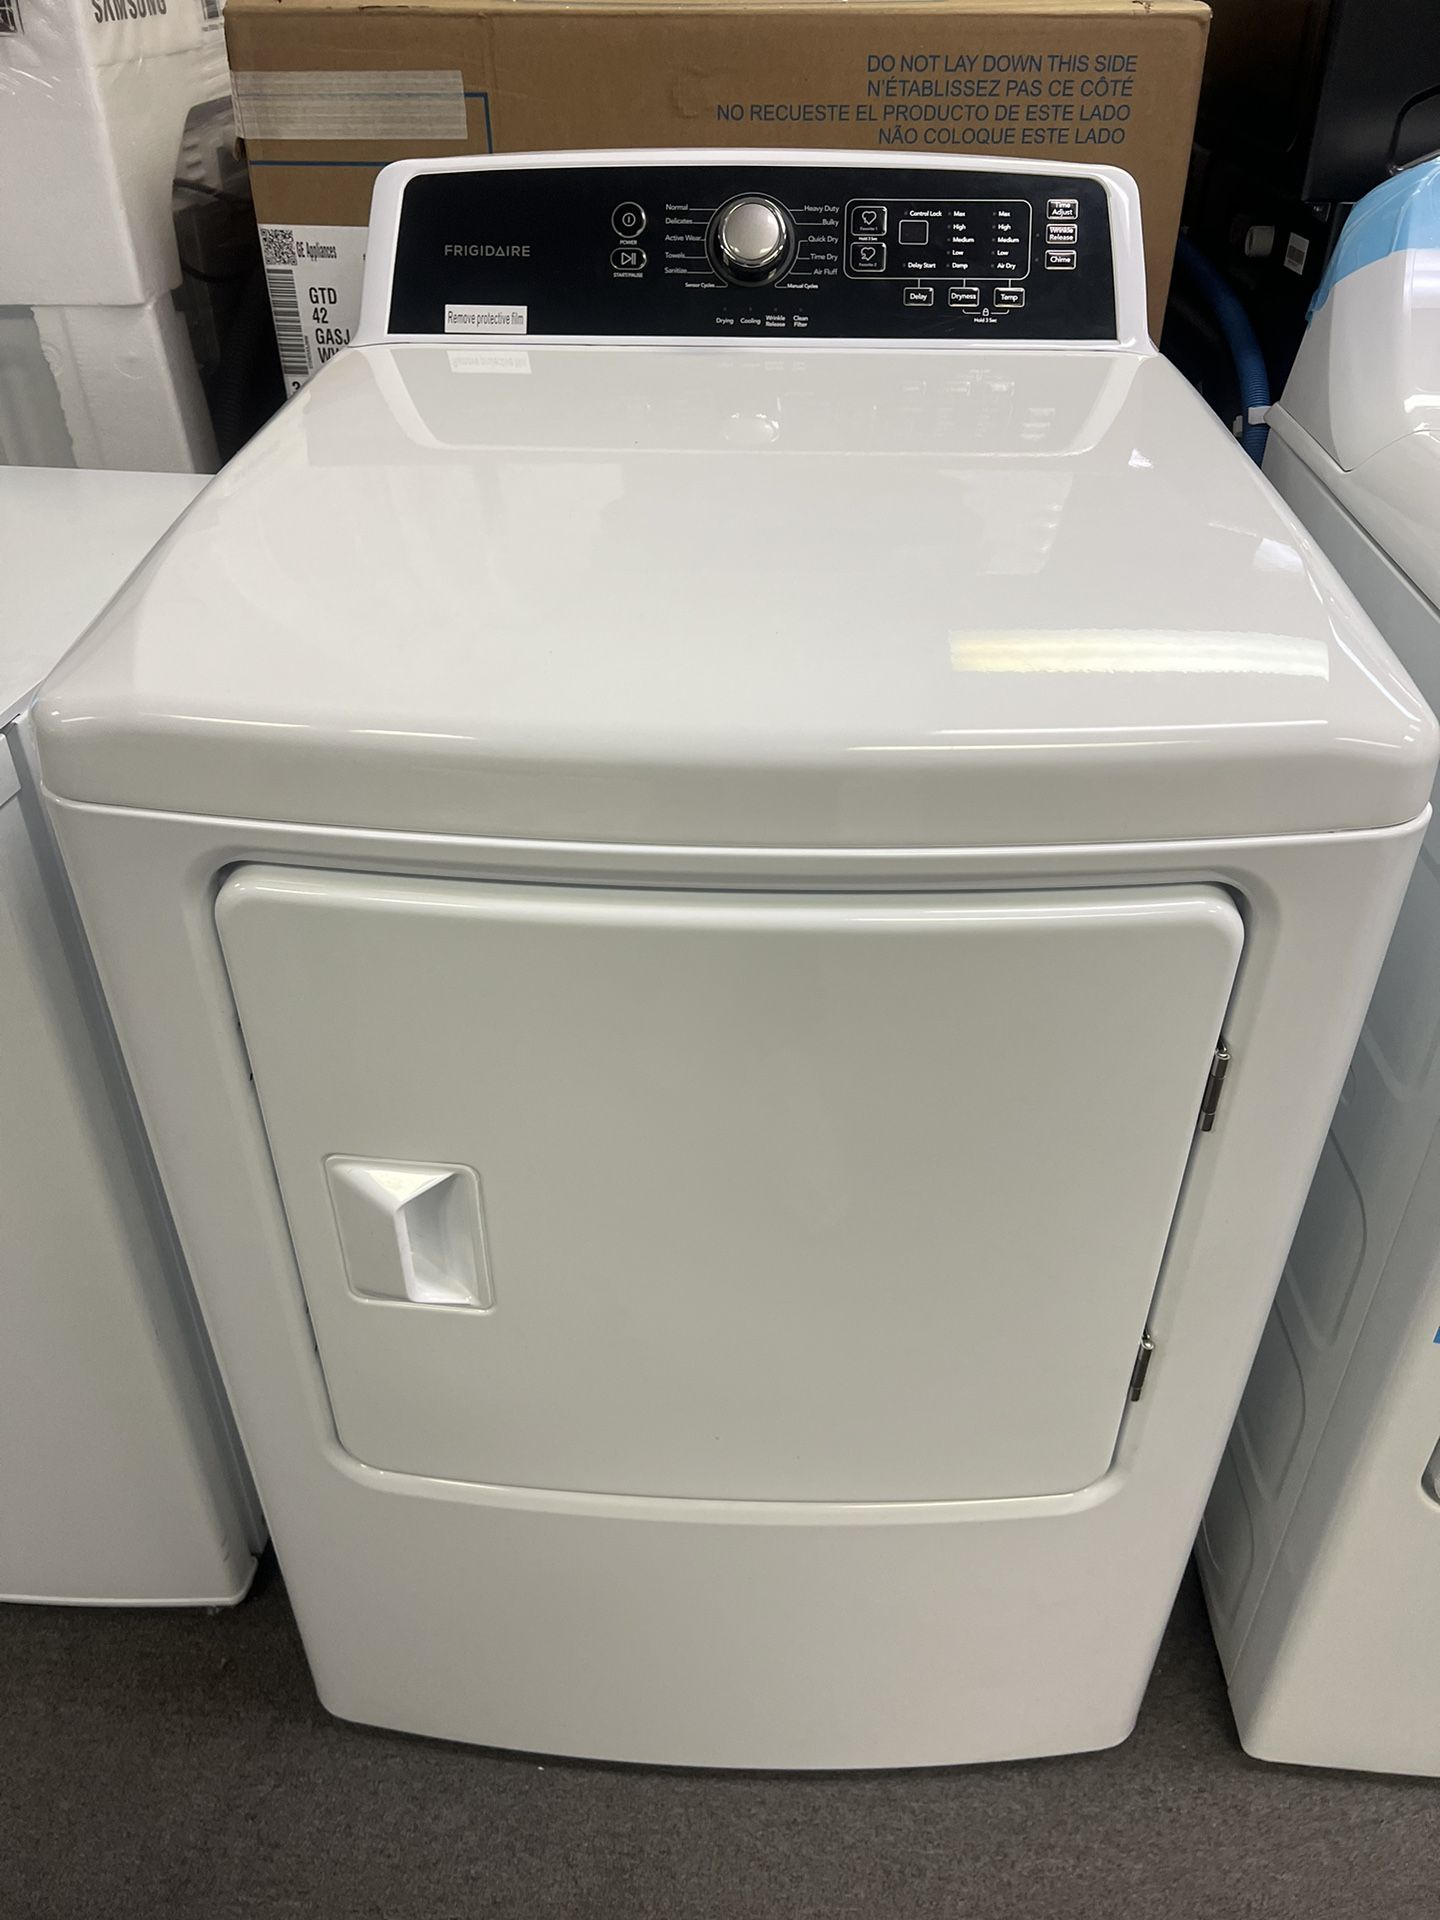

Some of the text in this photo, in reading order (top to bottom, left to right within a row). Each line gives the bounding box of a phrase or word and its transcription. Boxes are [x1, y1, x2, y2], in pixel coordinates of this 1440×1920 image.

[867, 54, 1138, 72] DO NOT LAY DOWN THIS SIDE
[867, 76, 1134, 97] N'ÉTABLISSEZ PAS CE CÔTÉ
[717, 104, 1131, 121] NO RECUESTE EL PRODUCTO DE ESTE LADO
[878, 125, 1126, 145] NÃO COLOQUE ESTE LADO
[804, 205, 840, 213] Heavy Duty
[1052, 209, 1073, 217] Adjust
[822, 219, 839, 227] Bulky
[953, 224, 967, 232] High
[998, 224, 1012, 232] High
[808, 235, 839, 244] Quick Dry
[296, 241, 337, 262] GE Appliances
[444, 245, 531, 257] FRIGIDAIRE
[827, 253, 839, 262] Dry
[907, 262, 923, 270] Delay
[1005, 263, 1017, 271] Dry
[309, 287, 337, 305] GTD
[909, 293, 928, 302] Delay
[951, 292, 977, 302] Dryness
[1000, 294, 1019, 303] Temp
[312, 307, 329, 324] 42
[447, 310, 524, 328] Remove protective film
[716, 317, 734, 325] Drying
[740, 317, 761, 326] Cooling
[315, 328, 350, 345] GASJ
